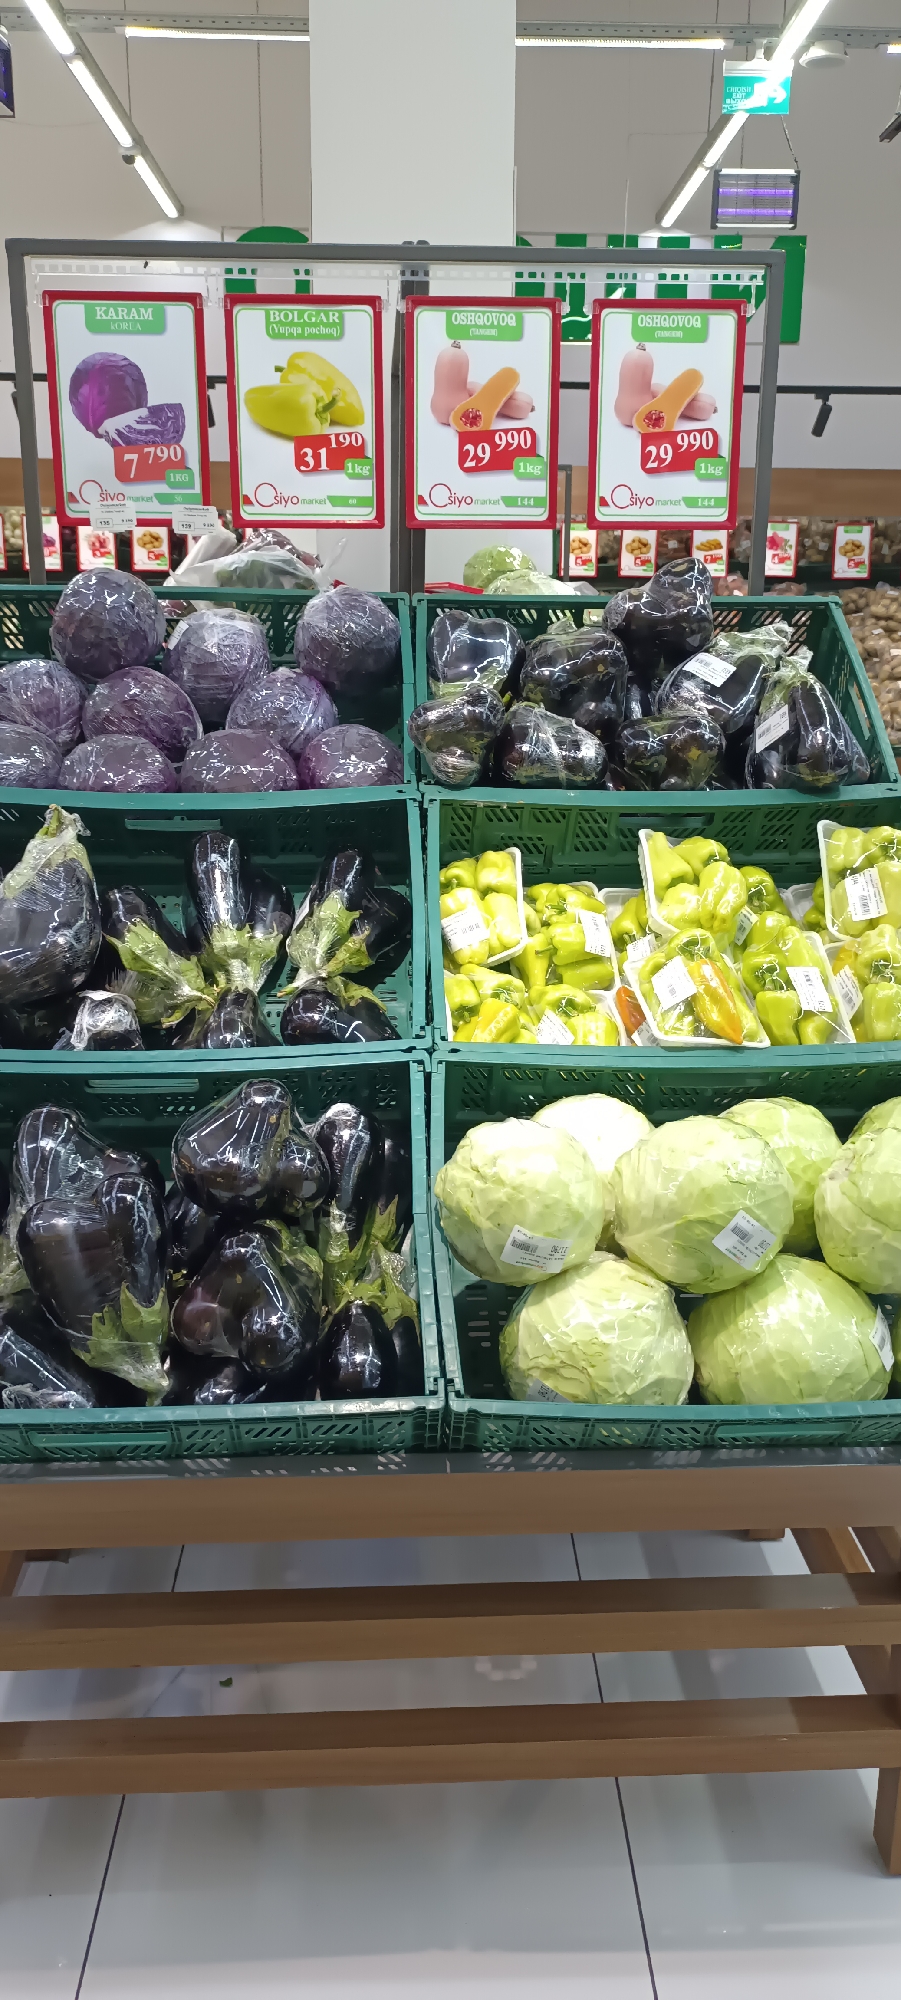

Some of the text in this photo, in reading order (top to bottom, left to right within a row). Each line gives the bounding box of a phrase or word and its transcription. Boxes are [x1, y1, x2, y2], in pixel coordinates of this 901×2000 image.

[95, 306, 153, 320] KARAM
[269, 310, 340, 322] BOLGAR
[451, 312, 517, 326] OSHQOVOQ
[637, 314, 702, 328] OSHQOVOQ
[269, 324, 341, 337] (Yupqa pochoq)
[299, 432, 363, 471] 31 190
[462, 429, 532, 468] 29 990
[644, 430, 714, 469] 29 990
[123, 444, 182, 479] 7 790
[254, 482, 327, 508] Osiyo market
[429, 483, 501, 508] Osiyo market
[517, 497, 534, 506] 144
[610, 484, 682, 509] Osiyo market
[697, 498, 715, 507] 144
